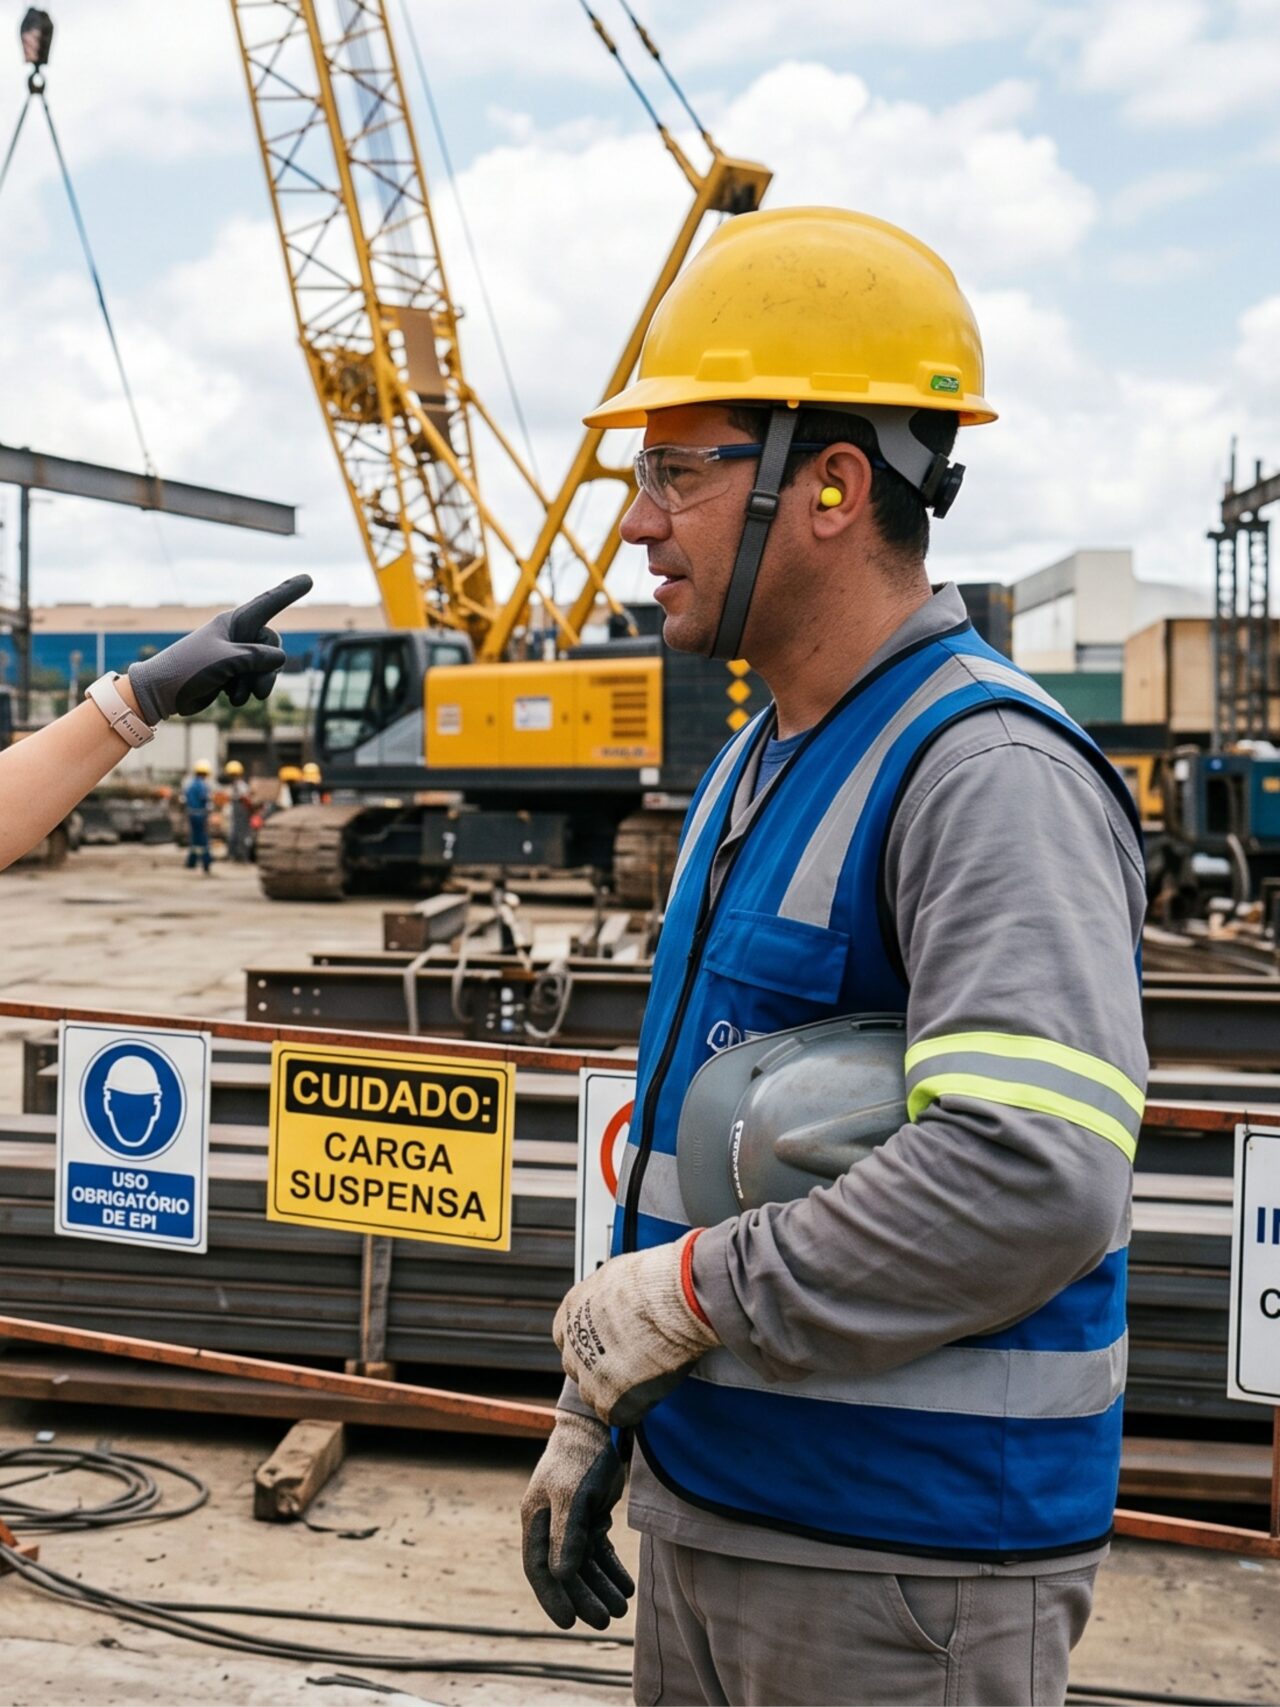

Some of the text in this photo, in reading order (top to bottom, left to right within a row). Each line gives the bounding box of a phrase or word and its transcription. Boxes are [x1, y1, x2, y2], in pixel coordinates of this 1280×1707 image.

[292, 1070, 492, 1123] CUIDADO:
[324, 1132, 453, 1174] CARGA
[112, 1171, 149, 1191] USO
[289, 1170, 486, 1222] SUSPENSA
[72, 1186, 190, 1216] OBRIGATÓRIO
[102, 1209, 157, 1231] DE EPI
